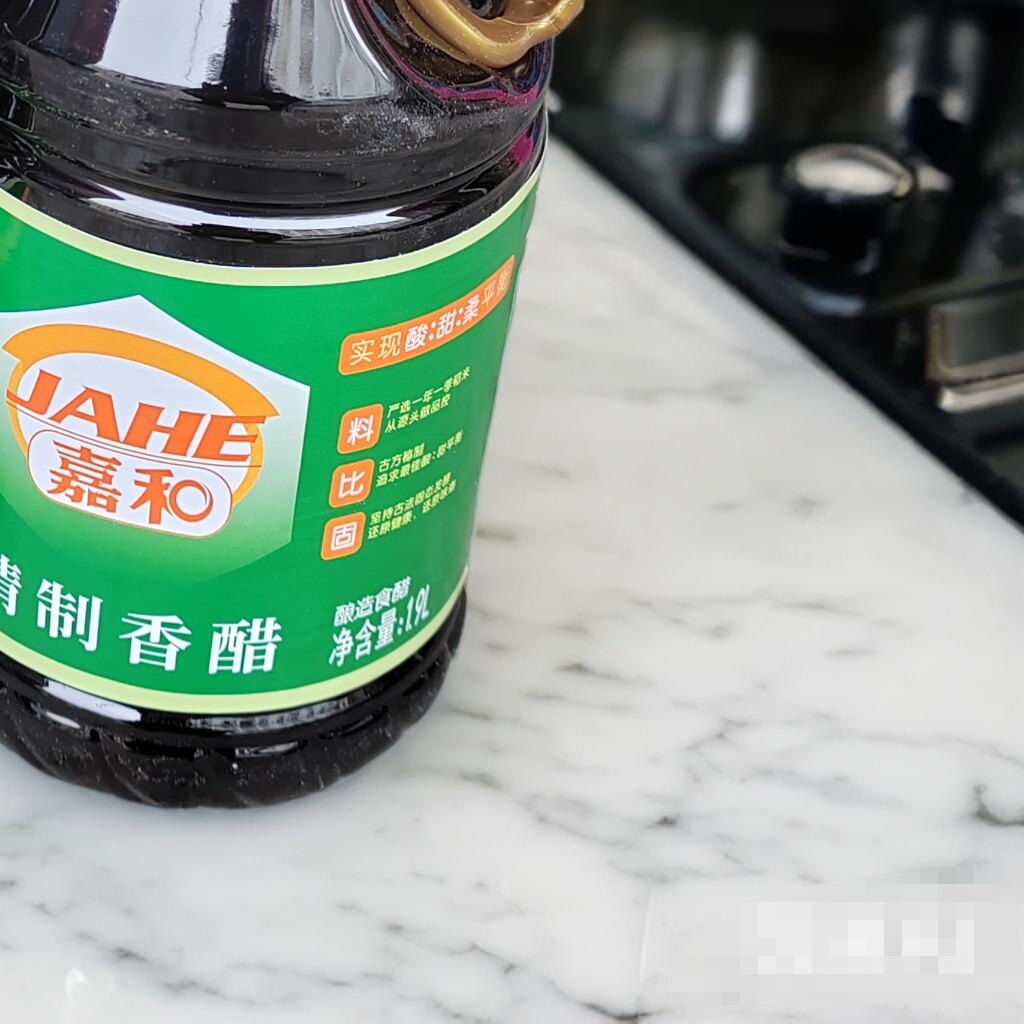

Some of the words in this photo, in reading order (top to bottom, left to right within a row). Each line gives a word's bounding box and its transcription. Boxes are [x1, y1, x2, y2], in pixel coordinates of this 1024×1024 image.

[6, 369, 266, 462] JAHE
[347, 414, 374, 446] 料
[46, 439, 214, 525] 嘉和
[338, 470, 366, 499] 比
[330, 521, 358, 552] 固
[333, 575, 412, 627] 酿造食醋
